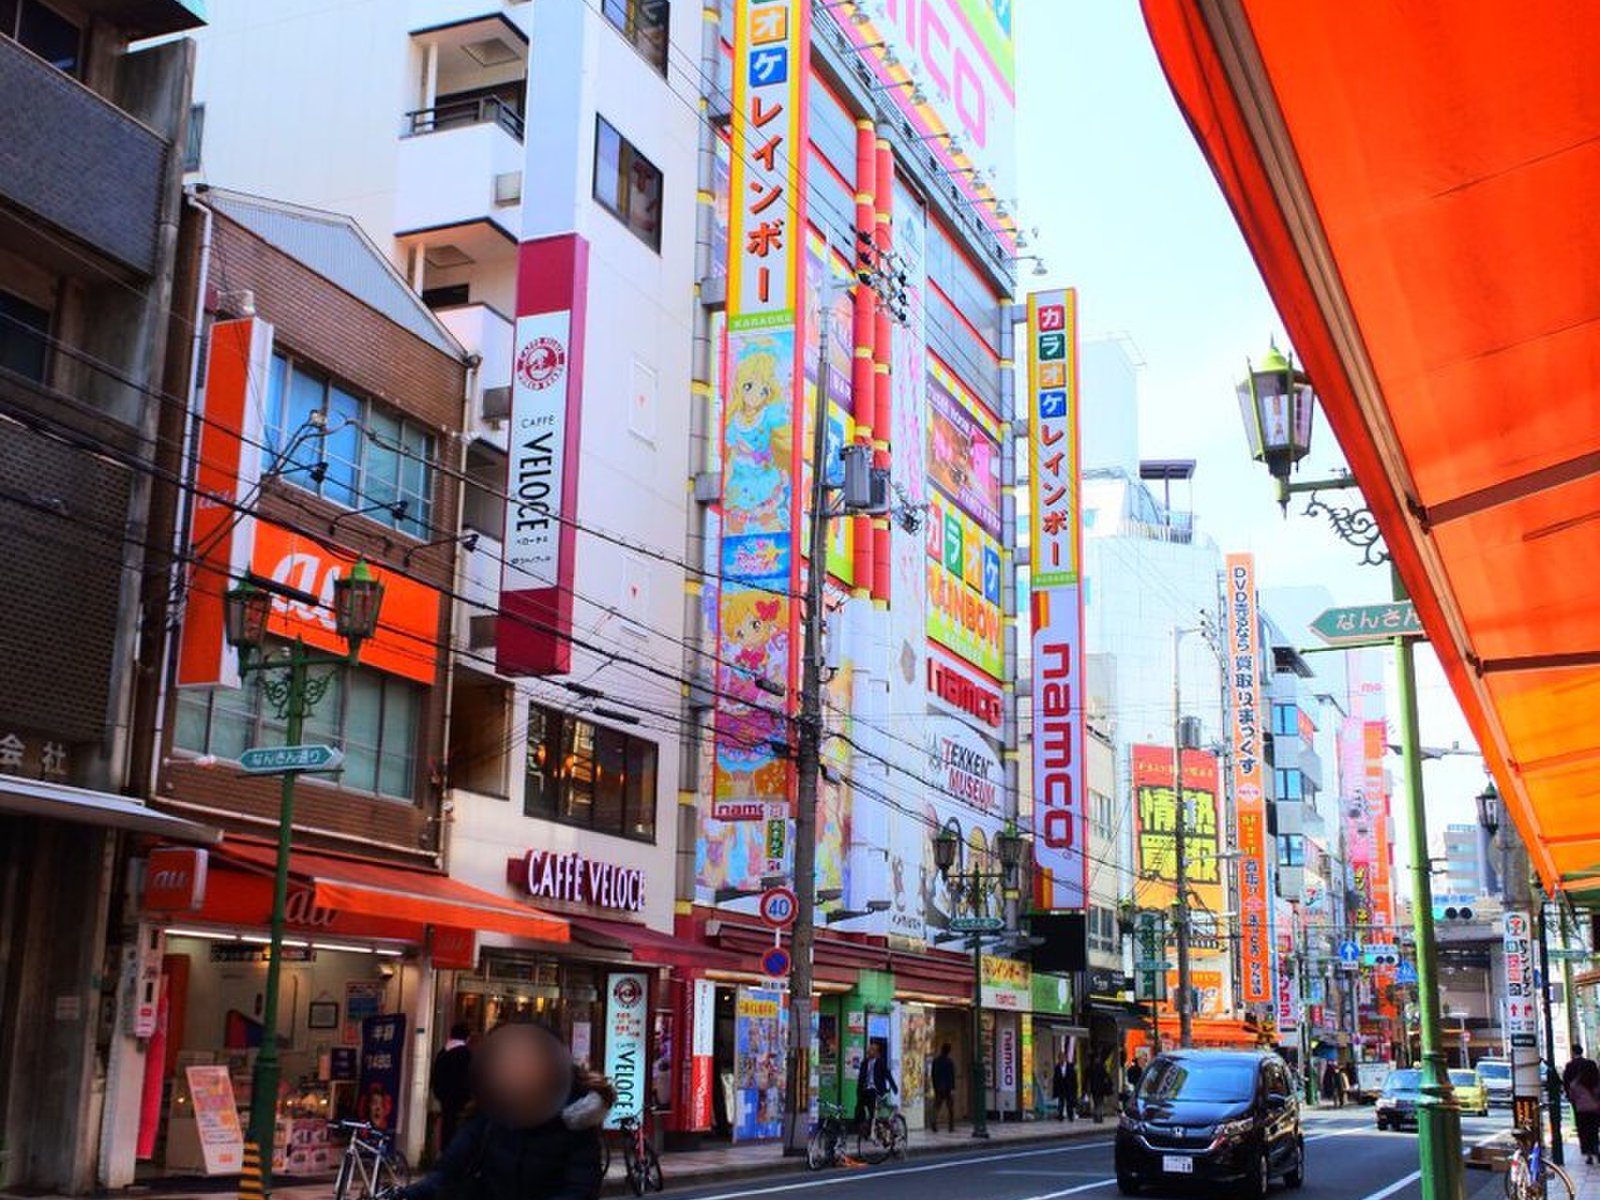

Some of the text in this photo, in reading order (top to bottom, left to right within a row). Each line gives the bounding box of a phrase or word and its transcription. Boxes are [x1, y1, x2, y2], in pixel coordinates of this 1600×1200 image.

[746, 97, 784, 303] レインボー
[1038, 305, 1066, 418] カラオケ
[516, 431, 553, 531] VELOCE
[1040, 424, 1067, 567] レインボー
[927, 656, 1003, 728] namco
[942, 737, 990, 779] TEKKEN
[1042, 643, 1073, 849] namco
[949, 766, 996, 810] MUSEUM
[588, 861, 645, 911] VELOCE
[767, 898, 790, 918] 40
[614, 1050, 635, 1109] VELOCE
[1004, 1031, 1015, 1087] namco
